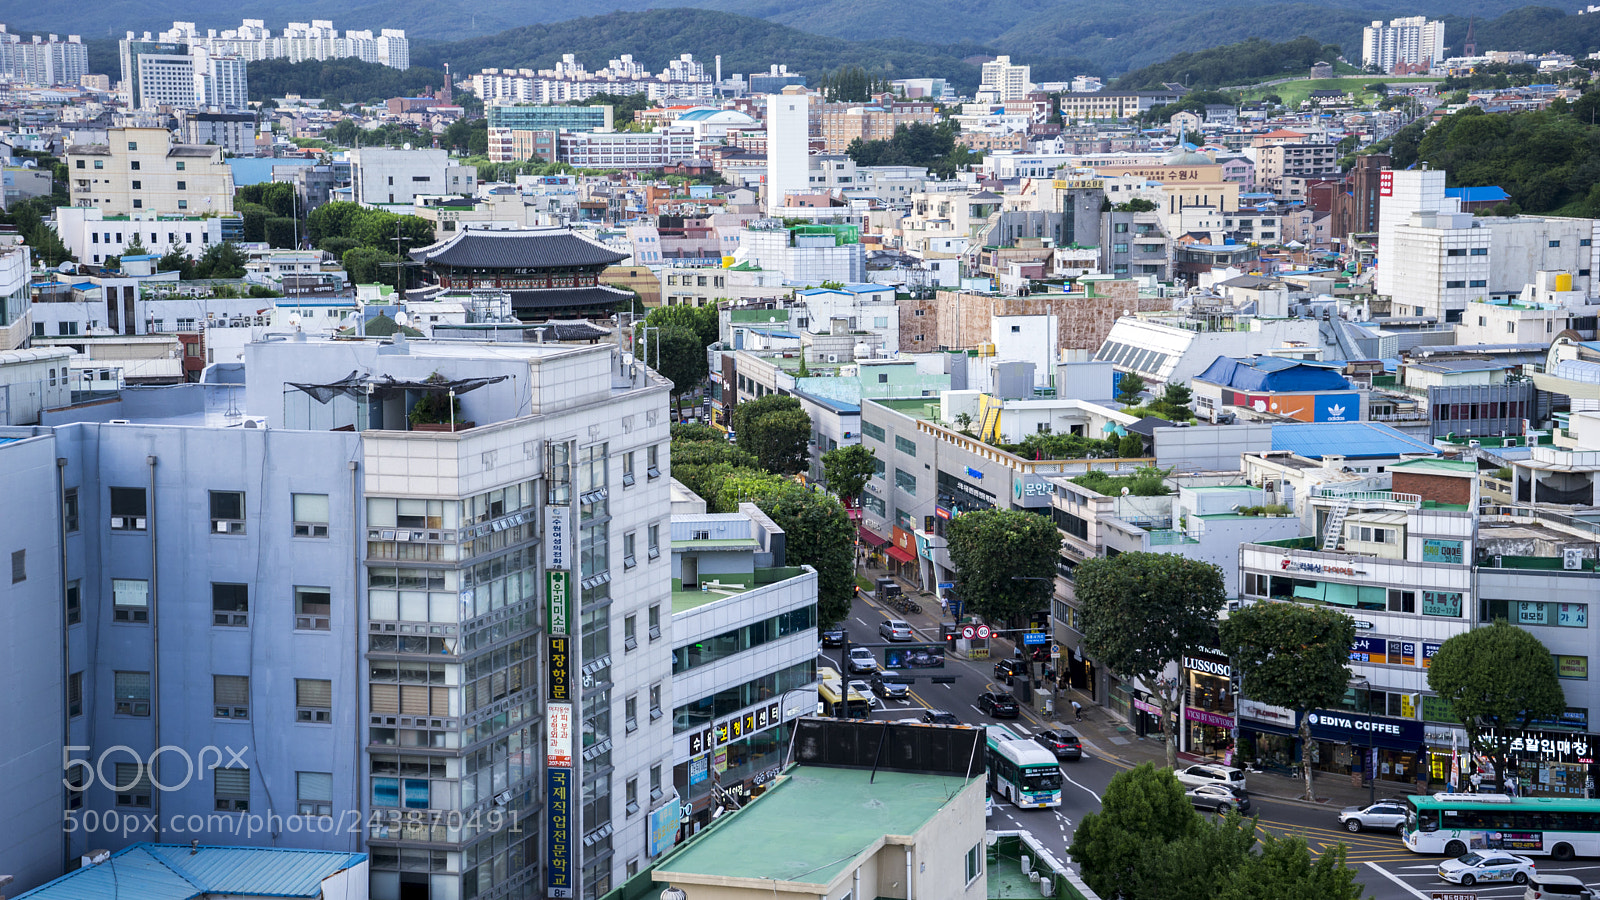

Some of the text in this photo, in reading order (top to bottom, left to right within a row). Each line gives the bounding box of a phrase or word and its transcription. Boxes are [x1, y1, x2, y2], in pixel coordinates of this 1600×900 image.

[1168, 170, 1198, 180] 수원사
[552, 519, 562, 564] 수원여성의전화
[1323, 565, 1355, 576] 다이어트
[553, 583, 563, 626] 우리미소
[980, 628, 988, 636] 60
[552, 639, 566, 699] 대장항문
[550, 714, 558, 747] 성형외과
[560, 714, 568, 739] 피부과
[1320, 715, 1400, 734] EDIYA COFFEE
[552, 772, 567, 885] 국제직업전문학교
[1451, 830, 1461, 839] 27
[554, 888, 566, 898] 8F
